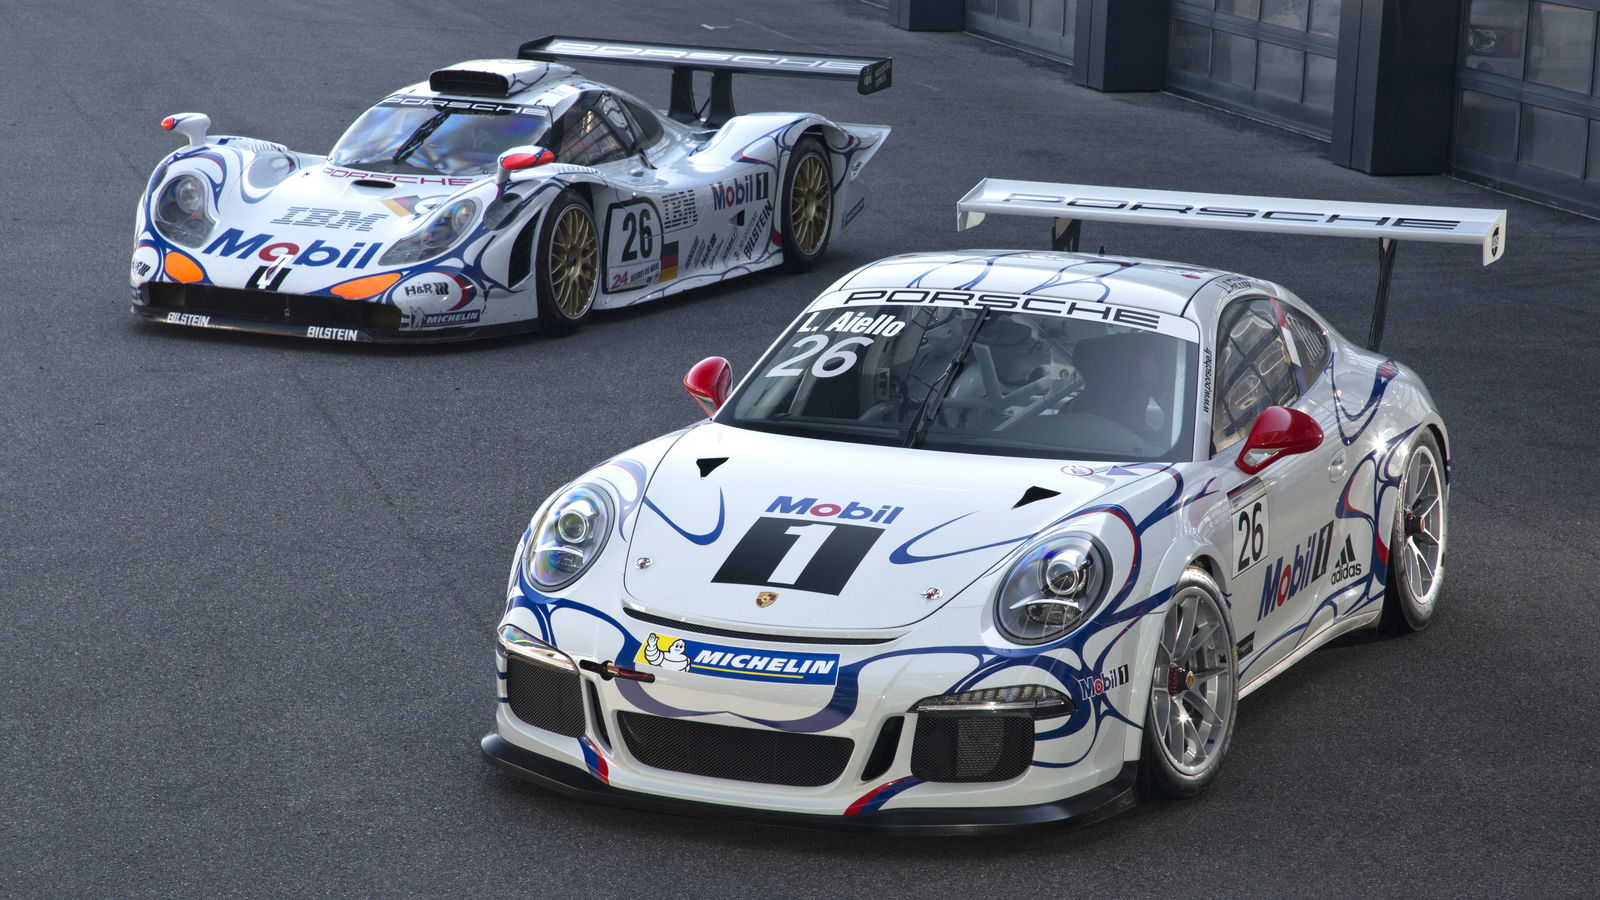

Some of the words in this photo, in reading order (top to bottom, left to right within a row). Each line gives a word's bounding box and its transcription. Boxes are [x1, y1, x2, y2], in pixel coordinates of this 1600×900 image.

[544, 42, 870, 70] PORSCHE
[385, 97, 548, 118] PORSCHE
[322, 167, 474, 187] PORSCHE
[709, 174, 752, 212] Mobil
[755, 172, 769, 201] 1
[270, 206, 390, 232] IBM
[661, 189, 698, 229] IBM
[1002, 192, 1461, 230] PORSCHE
[621, 208, 653, 262] 26
[743, 200, 773, 260] BILSTEIN
[201, 227, 384, 270] Mobil
[405, 282, 436, 296] H&R
[611, 271, 629, 289] 24
[166, 311, 211, 328] BILSTEIN
[426, 311, 479, 324] MICHELIN
[843, 289, 1161, 330] PORSCHE
[307, 325, 359, 342] BILSTEIN
[796, 312, 820, 334] L.
[830, 312, 906, 338] Aiello
[764, 334, 875, 379] 26
[1202, 347, 1213, 413] www.porsche.fr
[764, 496, 904, 525] Mobil
[1238, 501, 1264, 572] 26
[1257, 532, 1317, 622] Mobil
[1330, 562, 1362, 585] adidas
[693, 649, 836, 675] MICHELIN
[1078, 668, 1118, 700] Mobil
[1118, 664, 1130, 686] 1
